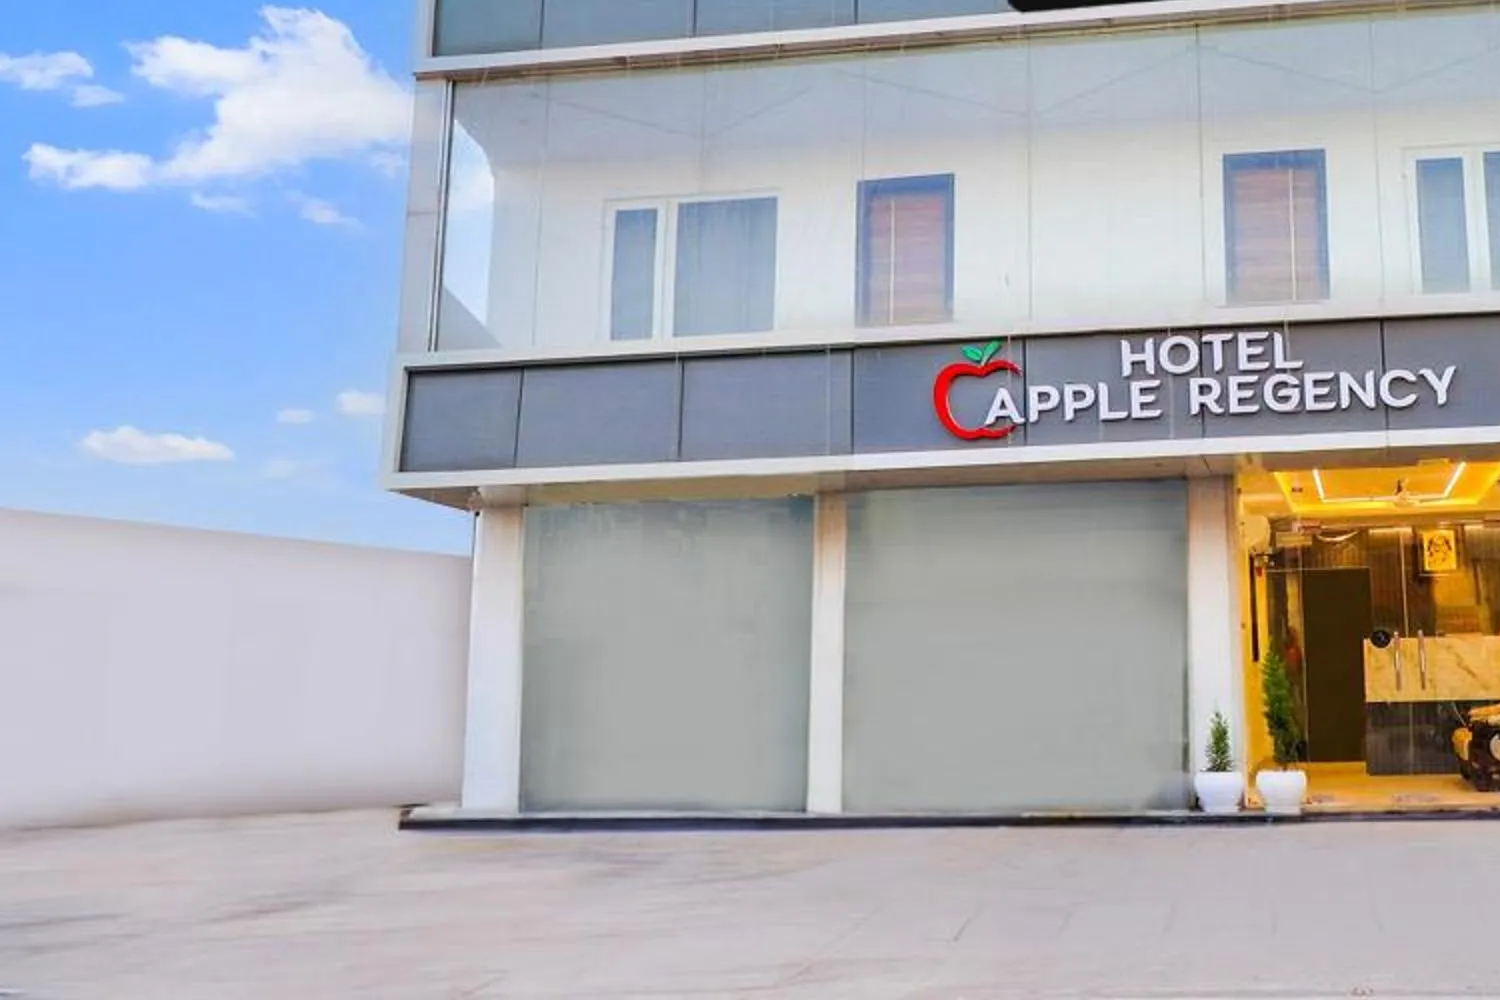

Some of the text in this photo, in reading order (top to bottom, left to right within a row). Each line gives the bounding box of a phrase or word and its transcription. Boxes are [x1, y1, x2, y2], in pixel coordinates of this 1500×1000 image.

[1120, 331, 1304, 377] HOTEL
[985, 366, 1457, 426] APPLE REGENCY
